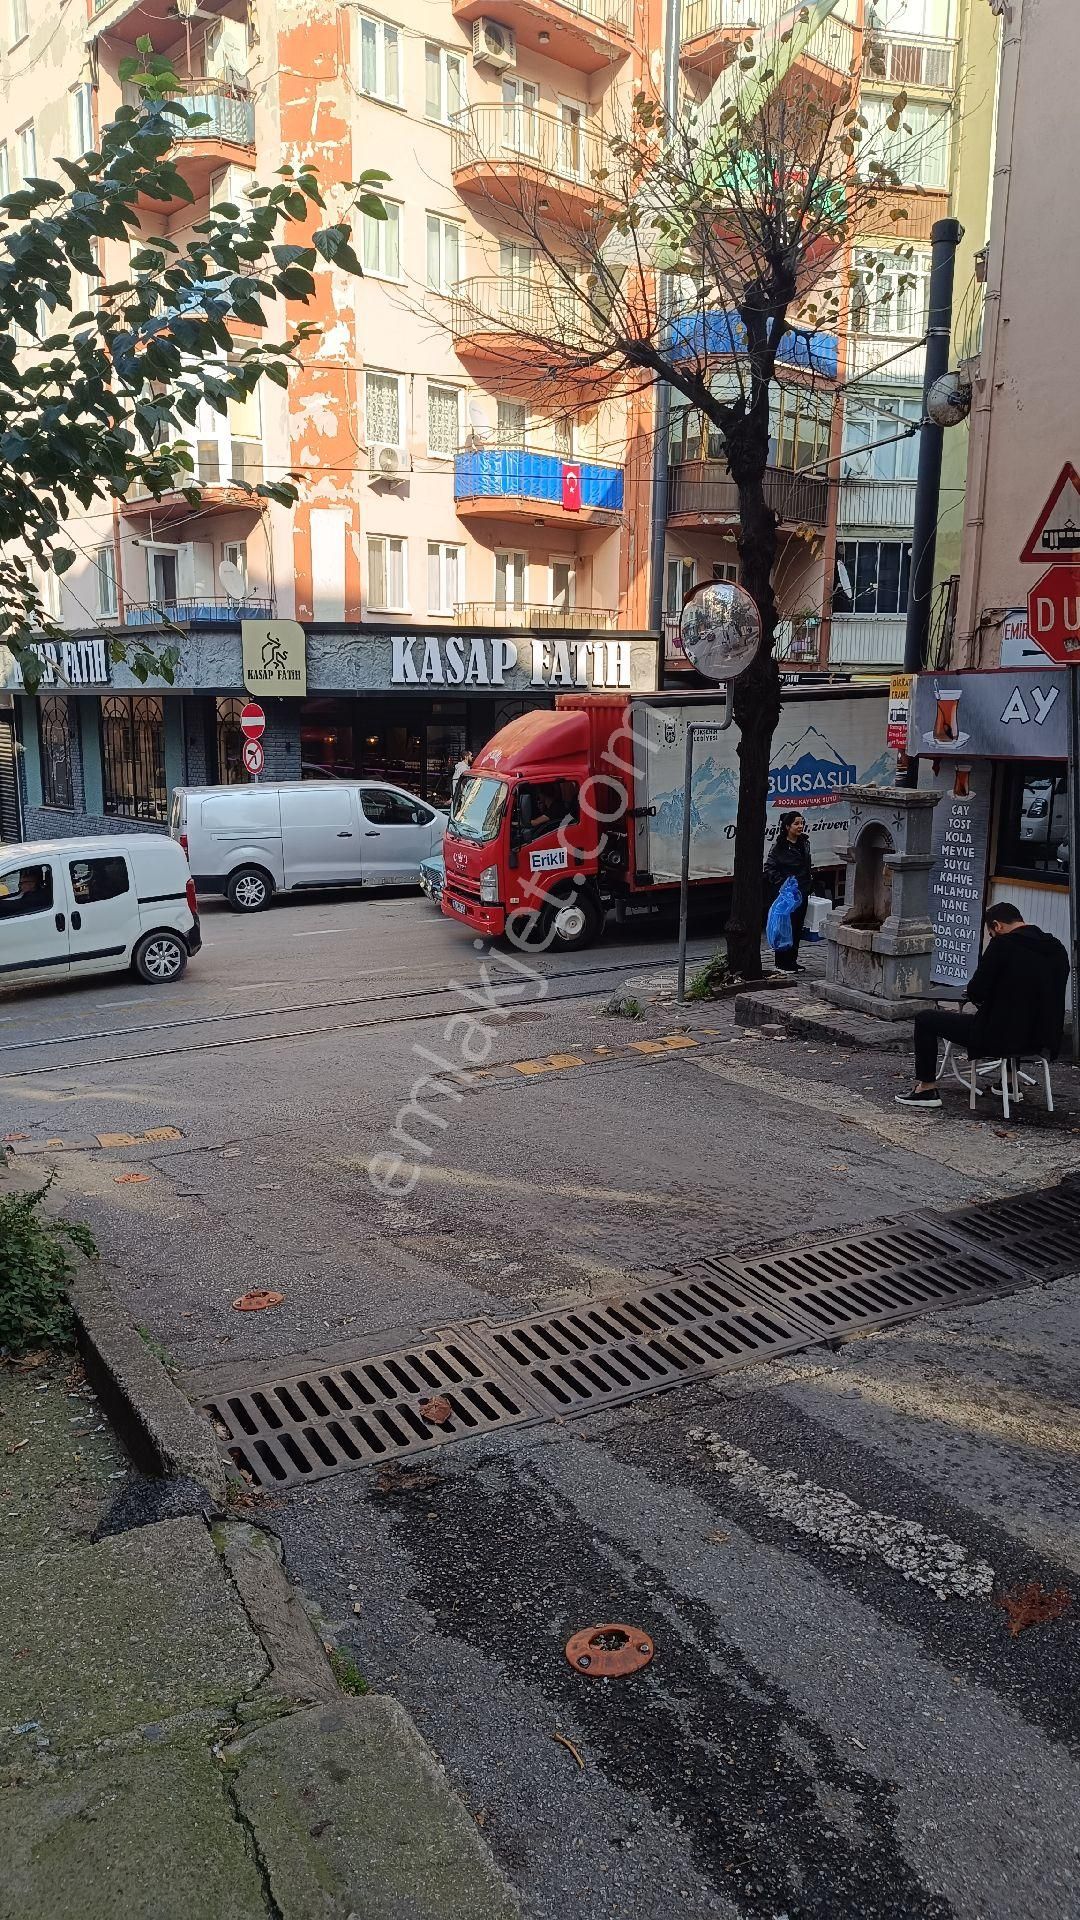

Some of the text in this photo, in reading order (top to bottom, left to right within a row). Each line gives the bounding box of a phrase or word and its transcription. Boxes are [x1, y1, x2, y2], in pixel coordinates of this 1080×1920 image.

[390, 636, 517, 684] KASAP
[247, 669, 274, 680] KASAP
[1000, 684, 1060, 726] AY
[948, 818, 972, 830] TOST
[945, 831, 972, 844] KOLA
[941, 845, 975, 858] MEYVE
[532, 851, 566, 868] Erikli
[943, 858, 971, 871] SUYU
[939, 871, 973, 886] KAHVE
[933, 884, 979, 900] IHLAMUR
[941, 898, 968, 912] NANE
[937, 910, 970, 926] LİMON
[932, 923, 952, 937] ADA
[934, 937, 971, 953] ORALET
[935, 964, 968, 979] AYRAN
